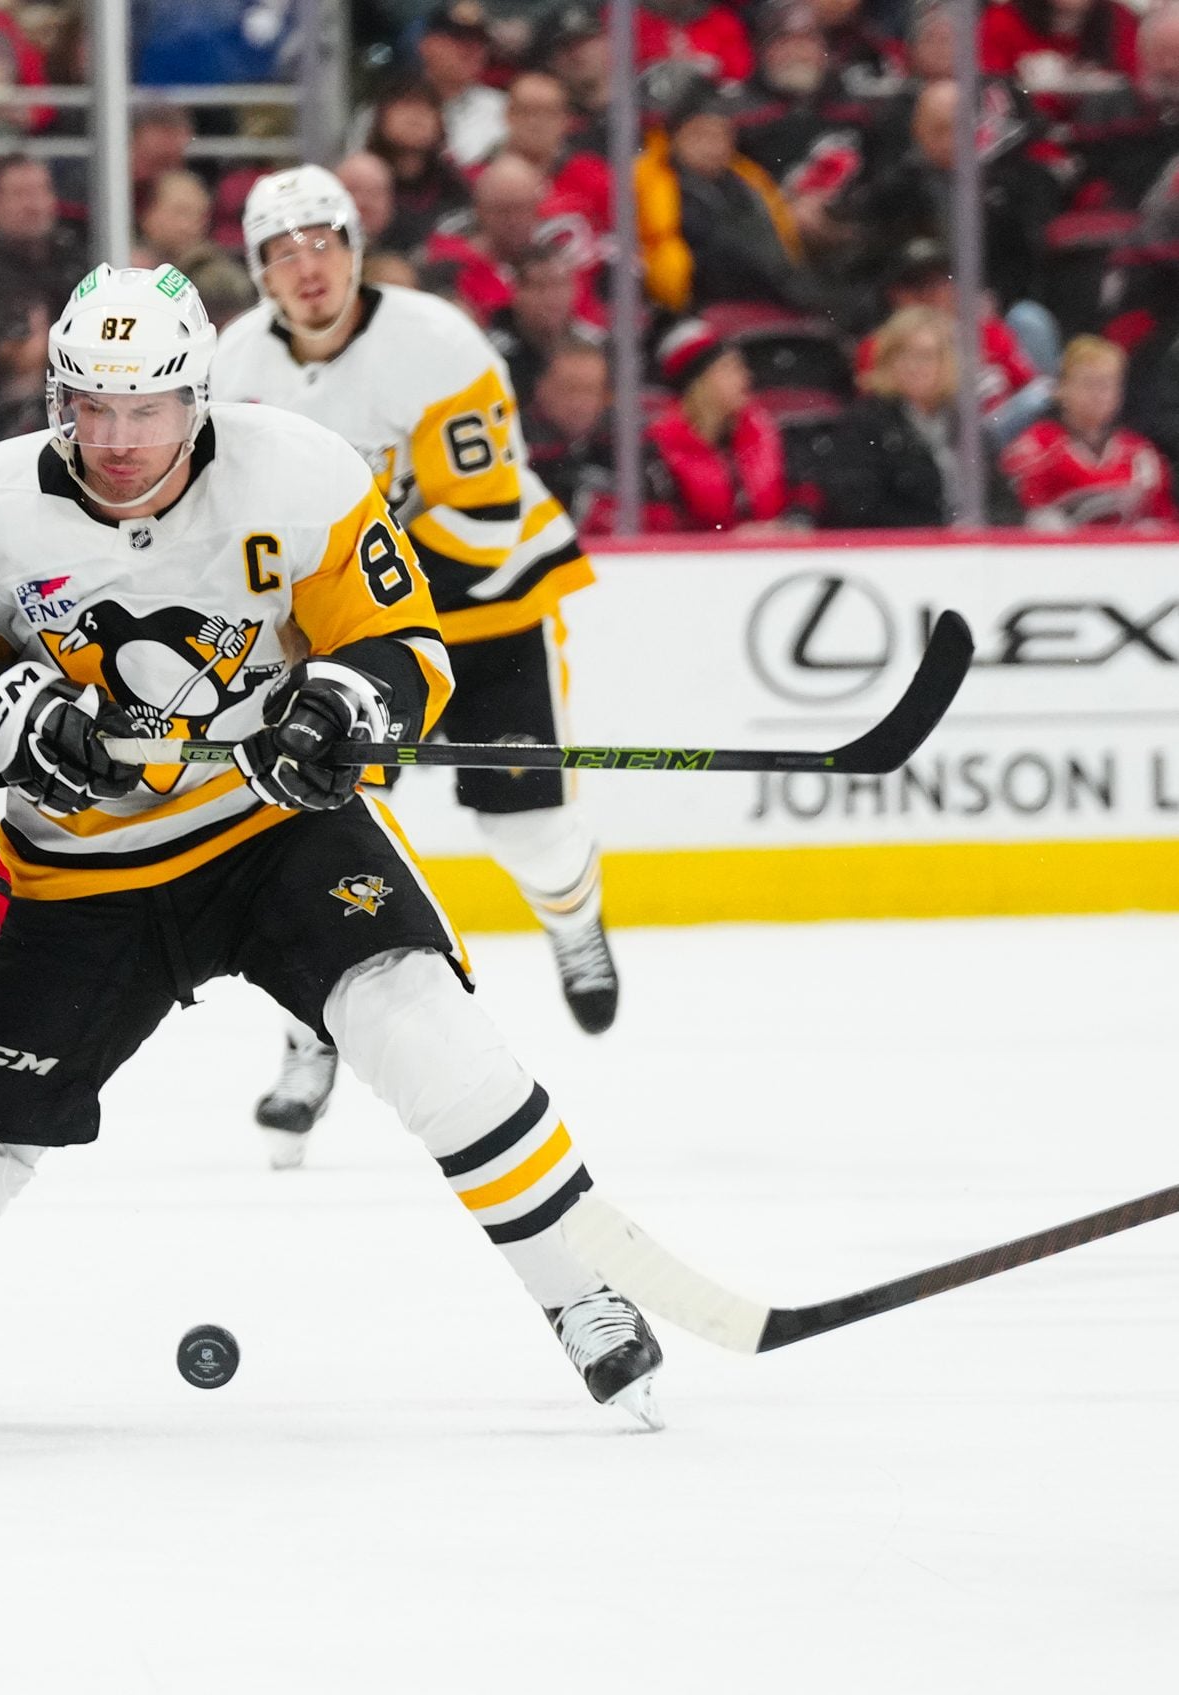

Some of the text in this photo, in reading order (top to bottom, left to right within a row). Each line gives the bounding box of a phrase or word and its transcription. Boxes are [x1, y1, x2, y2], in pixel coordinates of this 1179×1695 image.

[101, 317, 138, 341] 87
[93, 363, 141, 373] CCM
[242, 533, 282, 595] C
[288, 722, 323, 742] CCM
[388, 722, 404, 742] 87
[562, 748, 715, 770] CCM
[750, 752, 1119, 818] JOHNSON
